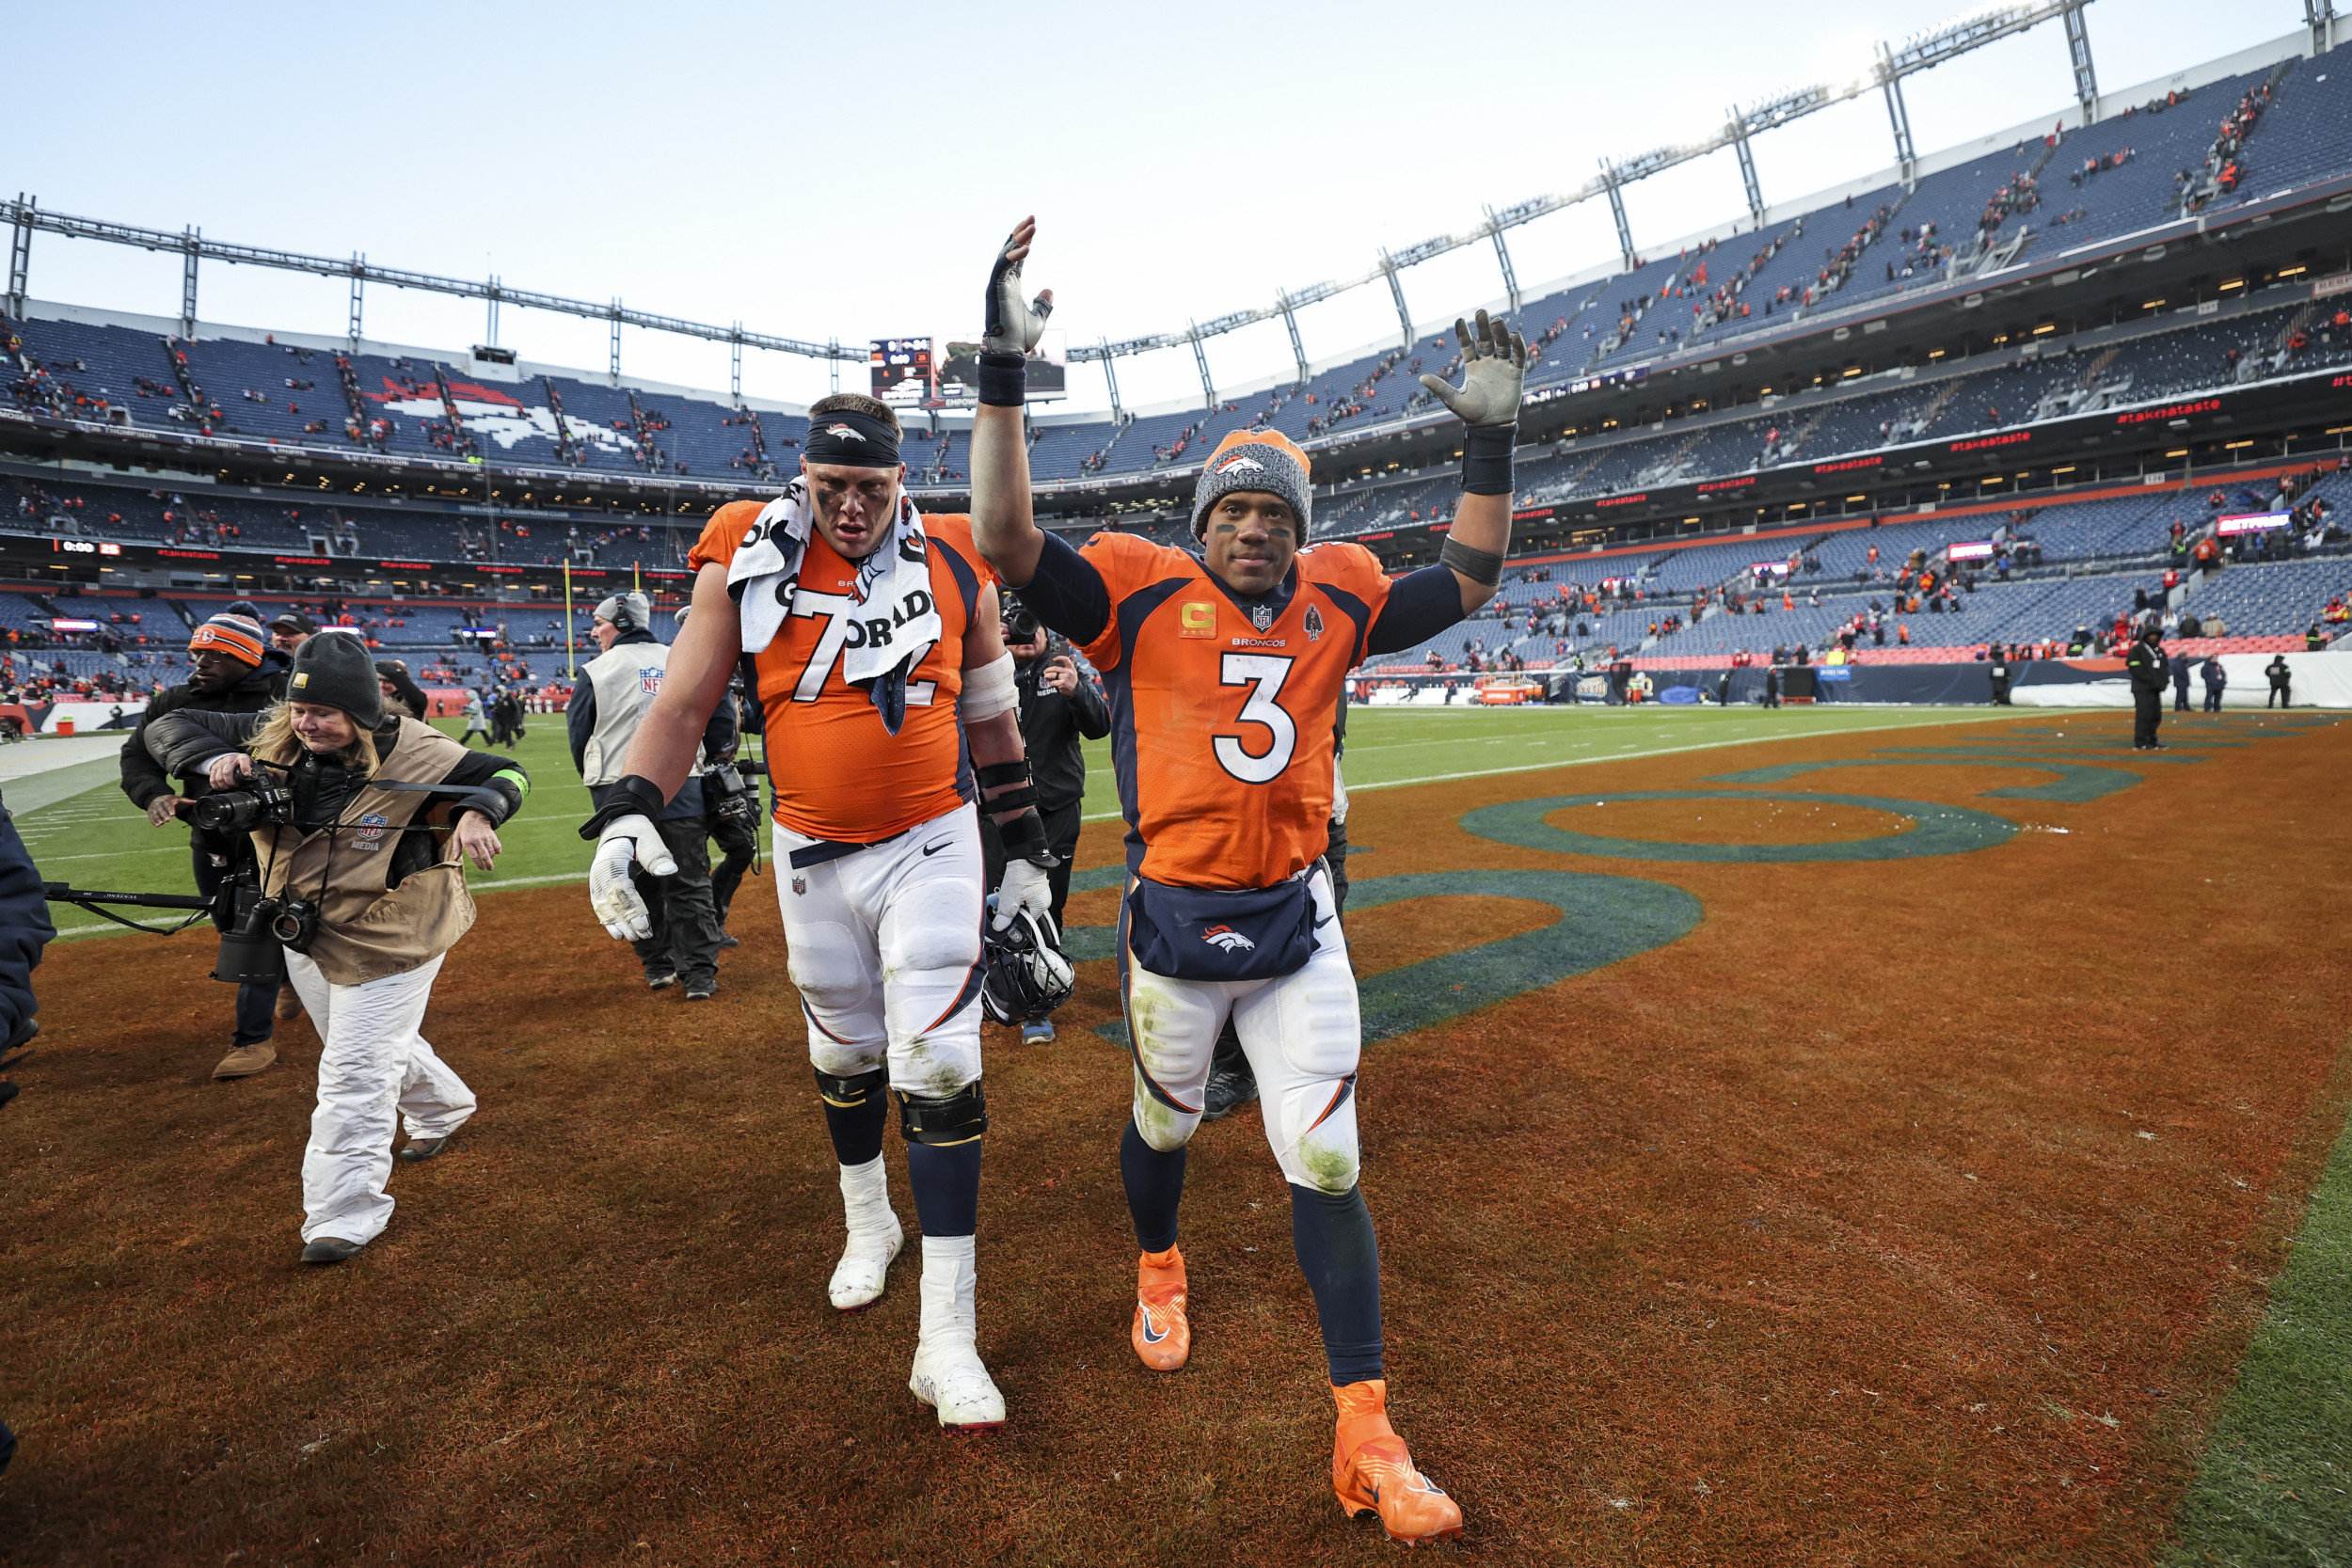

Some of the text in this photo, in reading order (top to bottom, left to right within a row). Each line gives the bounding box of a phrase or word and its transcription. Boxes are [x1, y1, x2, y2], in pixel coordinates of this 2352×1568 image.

[2118, 399, 2221, 424] #takeataste
[1949, 432, 2031, 452] #takeataste
[1814, 456, 1883, 473] #takeataste
[1697, 477, 1756, 492] #takeataste
[1596, 494, 1647, 507] #takeataste
[1513, 509, 1554, 519] takeataste
[1357, 532, 1394, 542] #takeataste
[63, 541, 94, 553] 0:00
[101, 544, 119, 555] 25
[157, 549, 220, 560] #takeataste
[275, 556, 331, 565] #takeataste
[380, 562, 432, 570] #takeataste
[846, 589, 941, 649] ORAD
[1182, 603, 1215, 628] C
[1256, 616, 1270, 626] NFL
[1232, 638, 1286, 647] BRONCOS
[643, 678, 662, 692] NF
[1037, 688, 1057, 697] MEDIA
[1212, 651, 1297, 785] 3
[351, 841, 379, 851] MEDIA
